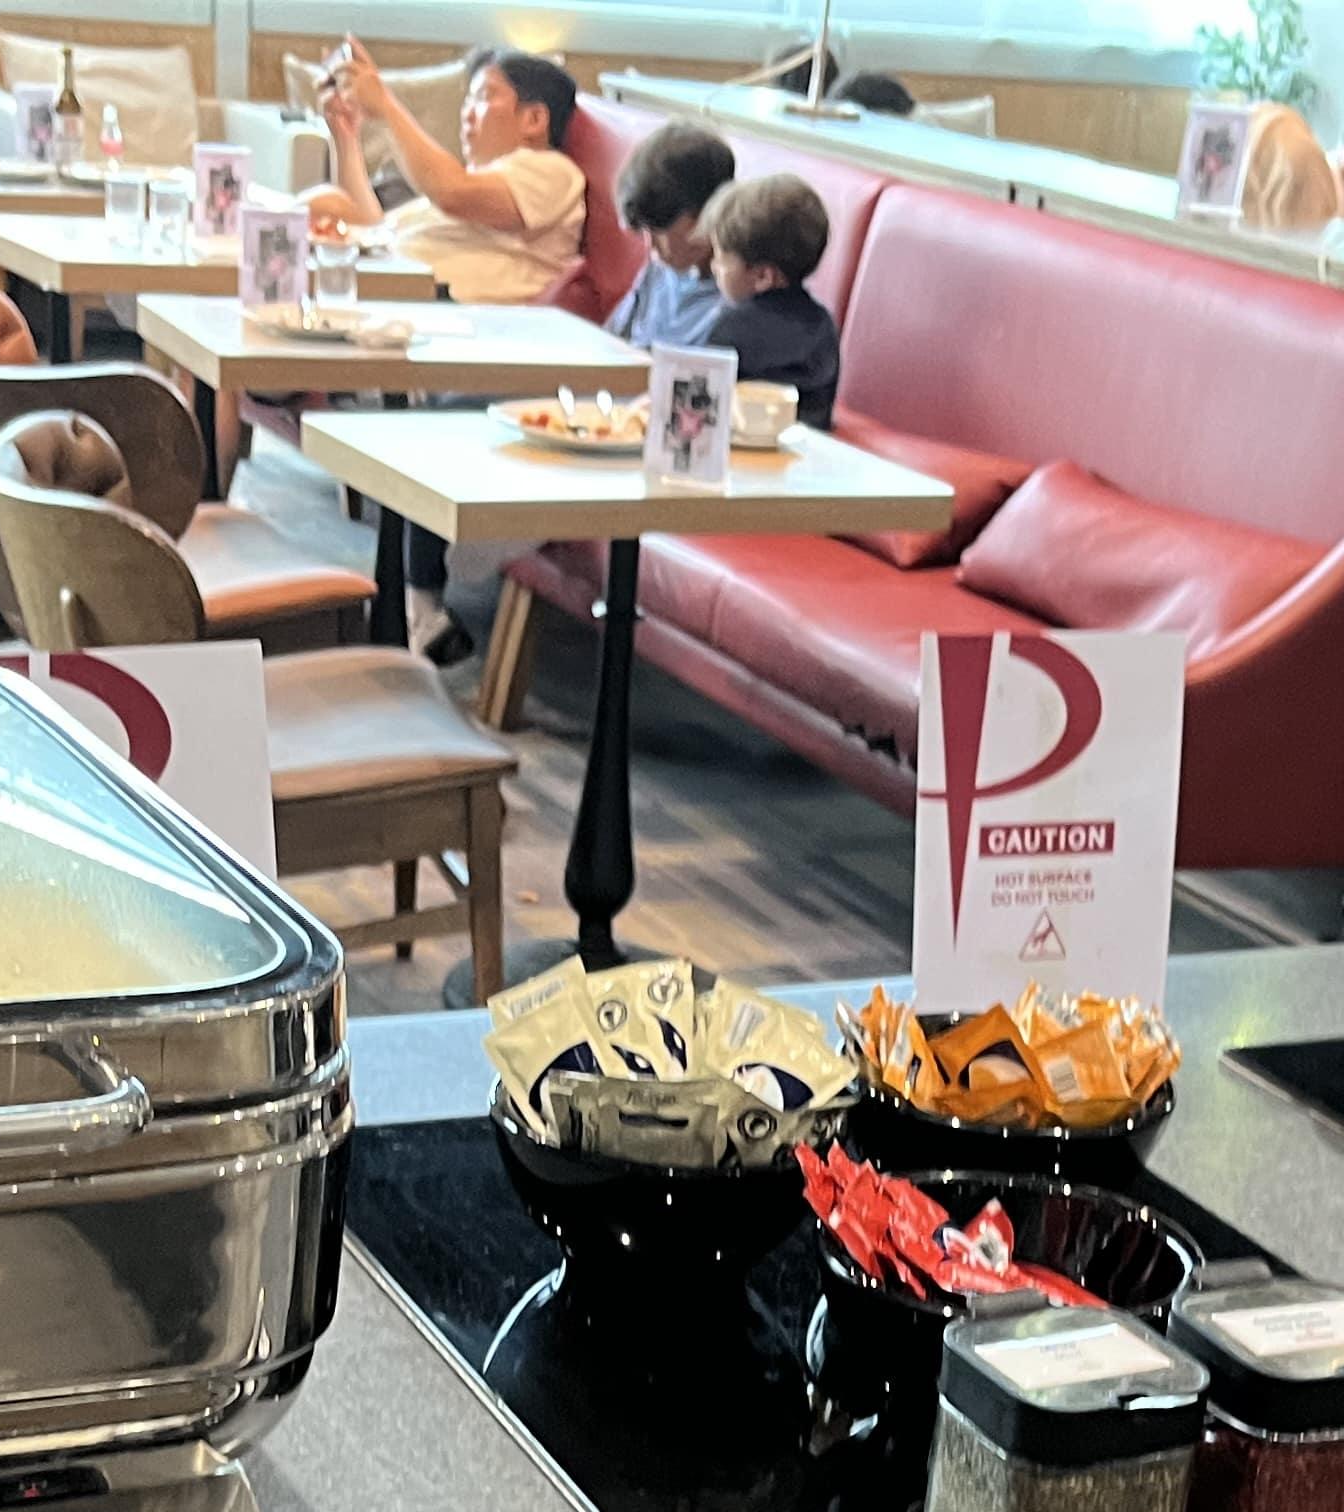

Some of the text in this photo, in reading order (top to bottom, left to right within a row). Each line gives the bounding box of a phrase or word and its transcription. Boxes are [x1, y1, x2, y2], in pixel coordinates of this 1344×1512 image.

[987, 825, 1107, 855] CAUTION
[994, 869, 1092, 888] HOT SURFACE
[991, 888, 1095, 906] DO NOT TOUCH
